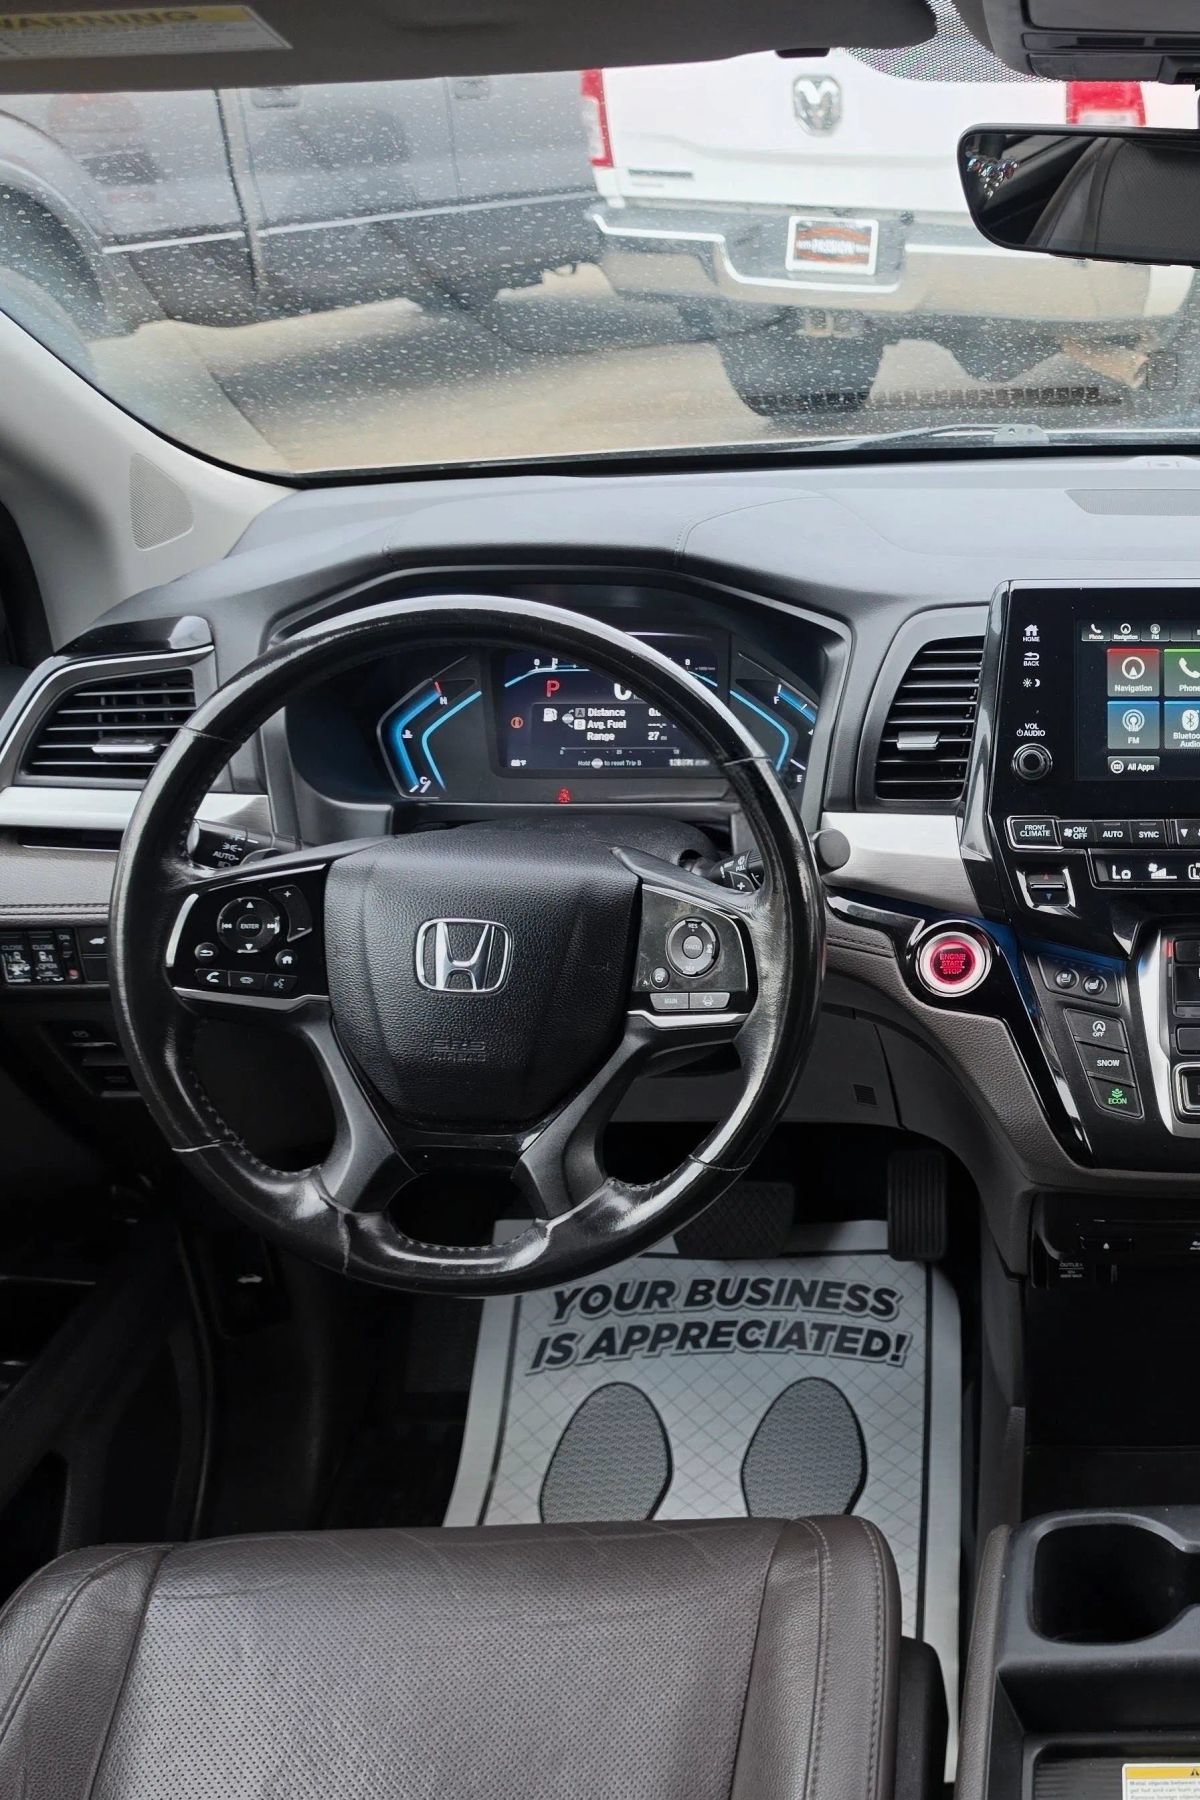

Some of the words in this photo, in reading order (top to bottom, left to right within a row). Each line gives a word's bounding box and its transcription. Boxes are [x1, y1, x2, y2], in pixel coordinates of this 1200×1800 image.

[546, 679, 560, 698] P
[1114, 684, 1153, 694] Navigation
[773, 695, 781, 705] F
[587, 707, 626, 717] Distance
[586, 719, 606, 730] Avg.
[607, 719, 627, 729] Fuel
[1024, 722, 1039, 730] VOL
[586, 731, 616, 742] Range
[647, 731, 660, 741] 27
[1127, 736, 1140, 744] FM
[1127, 763, 1137, 771] All
[1137, 763, 1155, 772] Apps
[1019, 830, 1051, 838] CLIMATE
[1072, 832, 1088, 840] OFF
[1102, 830, 1124, 838] AUTO
[1138, 830, 1160, 839] SYNC
[212, 851, 235, 861] AUTO
[1111, 864, 1132, 880] Lo
[939, 953, 966, 961] ENGINE
[1096, 1059, 1120, 1067] SNOW
[1108, 1097, 1128, 1105] ECON
[552, 1280, 676, 1321] YOUR
[683, 1277, 899, 1317] BUSINESS
[529, 1331, 579, 1370] IS
[583, 1320, 908, 1362] APPRECIATED!
